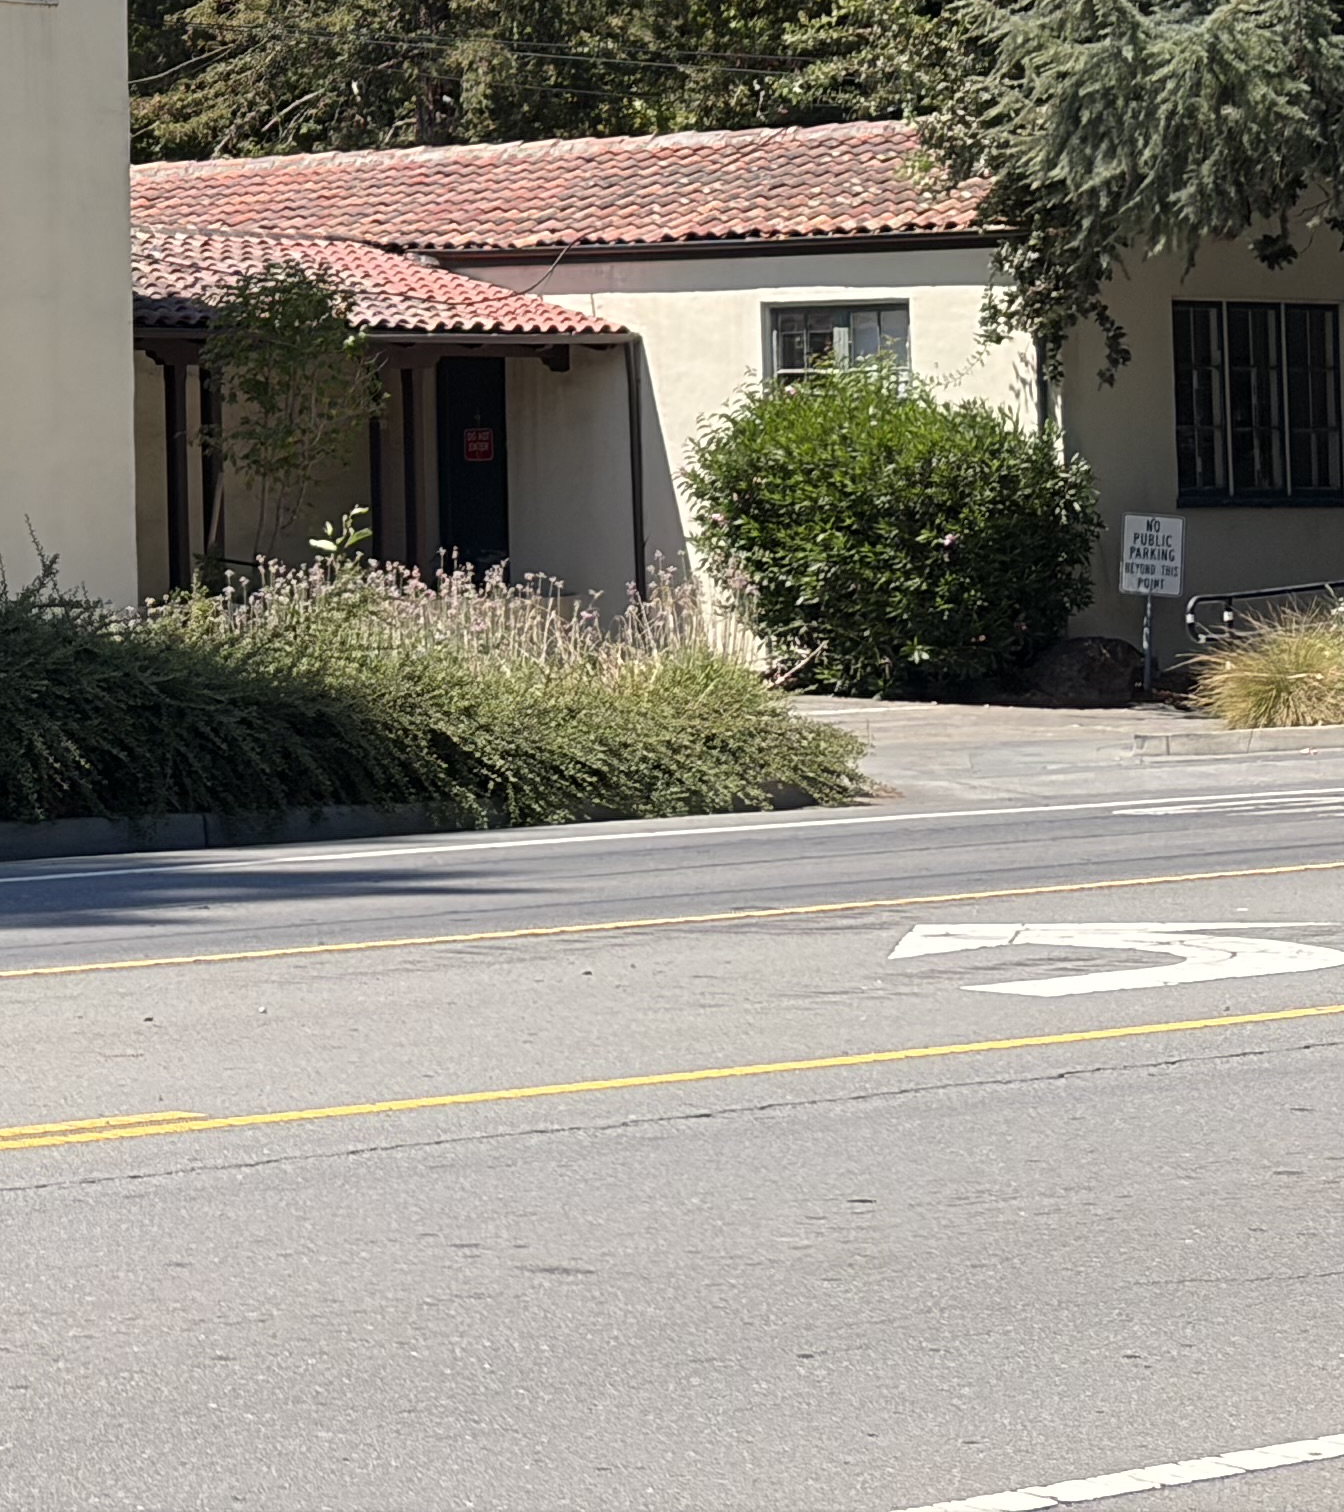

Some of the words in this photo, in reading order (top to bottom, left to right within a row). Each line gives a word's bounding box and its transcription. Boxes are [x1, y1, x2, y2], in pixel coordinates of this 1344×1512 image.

[1146, 519, 1161, 533] NO
[1133, 532, 1173, 548] PUBLIC
[1128, 546, 1176, 563] PARKING
[1124, 562, 1156, 575] BEYOND
[1161, 565, 1179, 577] THIS
[1137, 577, 1165, 590] POINT
